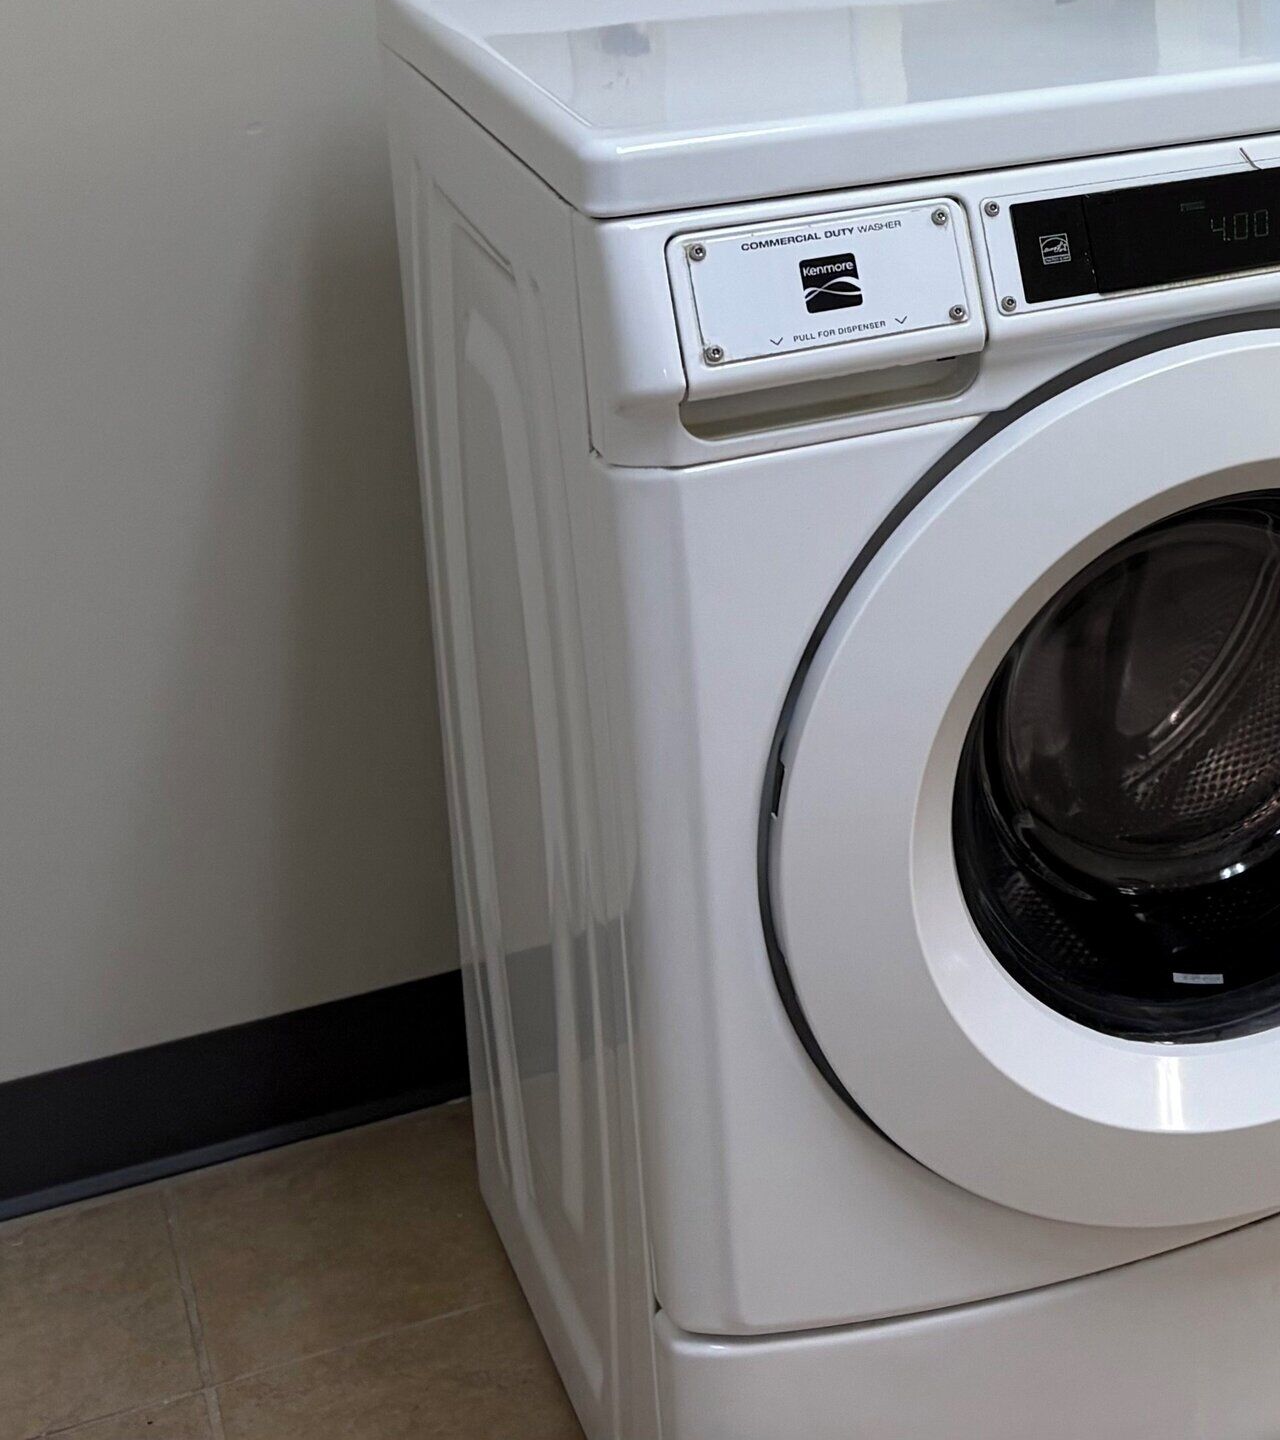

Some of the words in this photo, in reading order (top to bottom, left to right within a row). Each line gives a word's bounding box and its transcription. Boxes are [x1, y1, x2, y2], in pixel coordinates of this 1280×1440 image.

[741, 232, 822, 251] COMMERCIAL
[824, 227, 855, 239] DUTY
[856, 220, 902, 233] WASHER
[802, 260, 855, 277] Kenmore
[793, 334, 816, 342] PULL
[817, 328, 836, 338] FOR
[837, 320, 887, 335] DISPENSER
